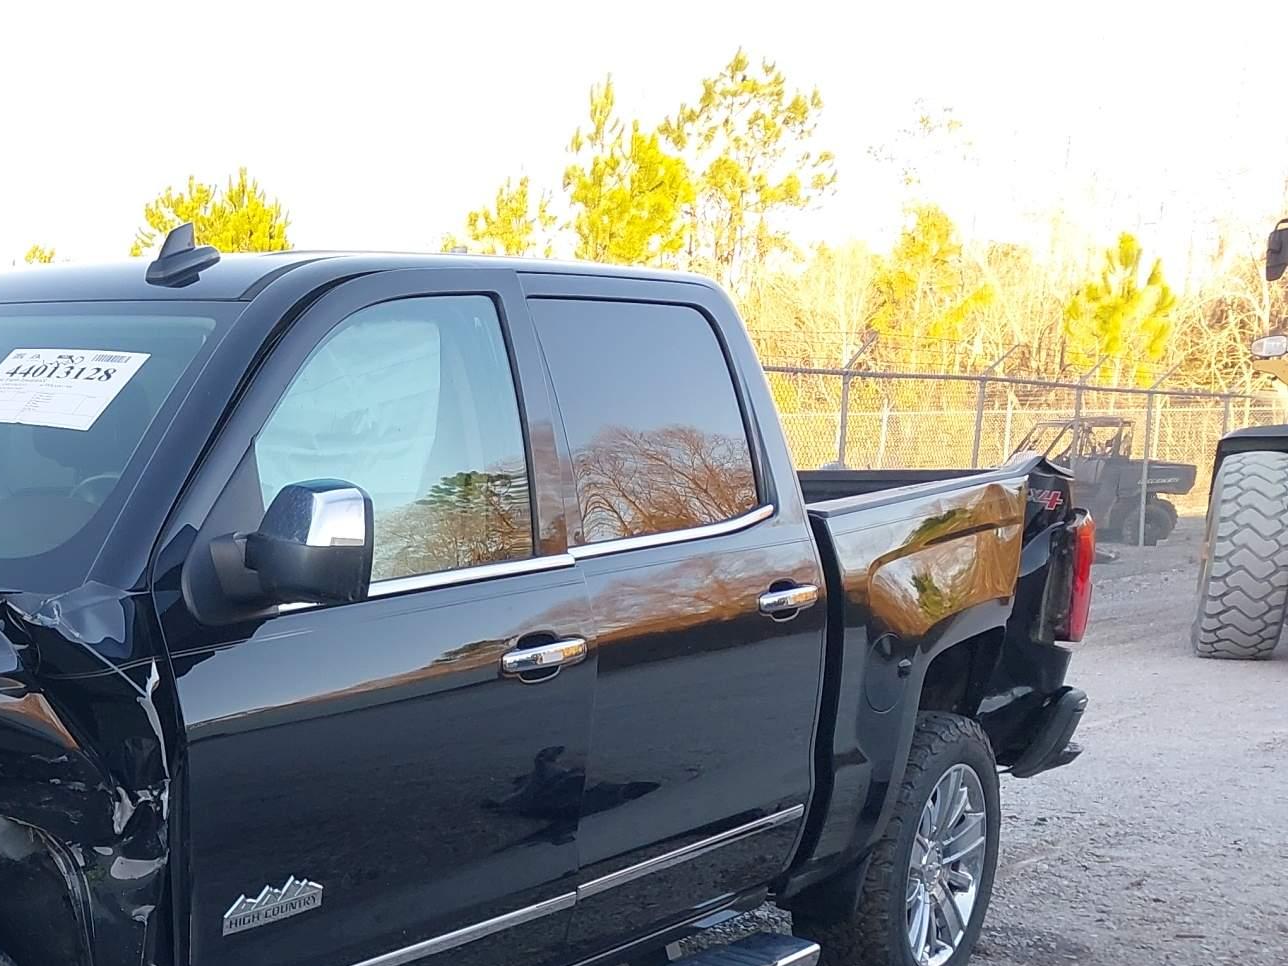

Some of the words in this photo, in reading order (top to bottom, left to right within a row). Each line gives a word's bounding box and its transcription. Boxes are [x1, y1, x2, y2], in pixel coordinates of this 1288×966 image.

[5, 363, 118, 382] 44013128
[228, 913, 260, 929] HIGH
[264, 893, 317, 919] COUNTRY
